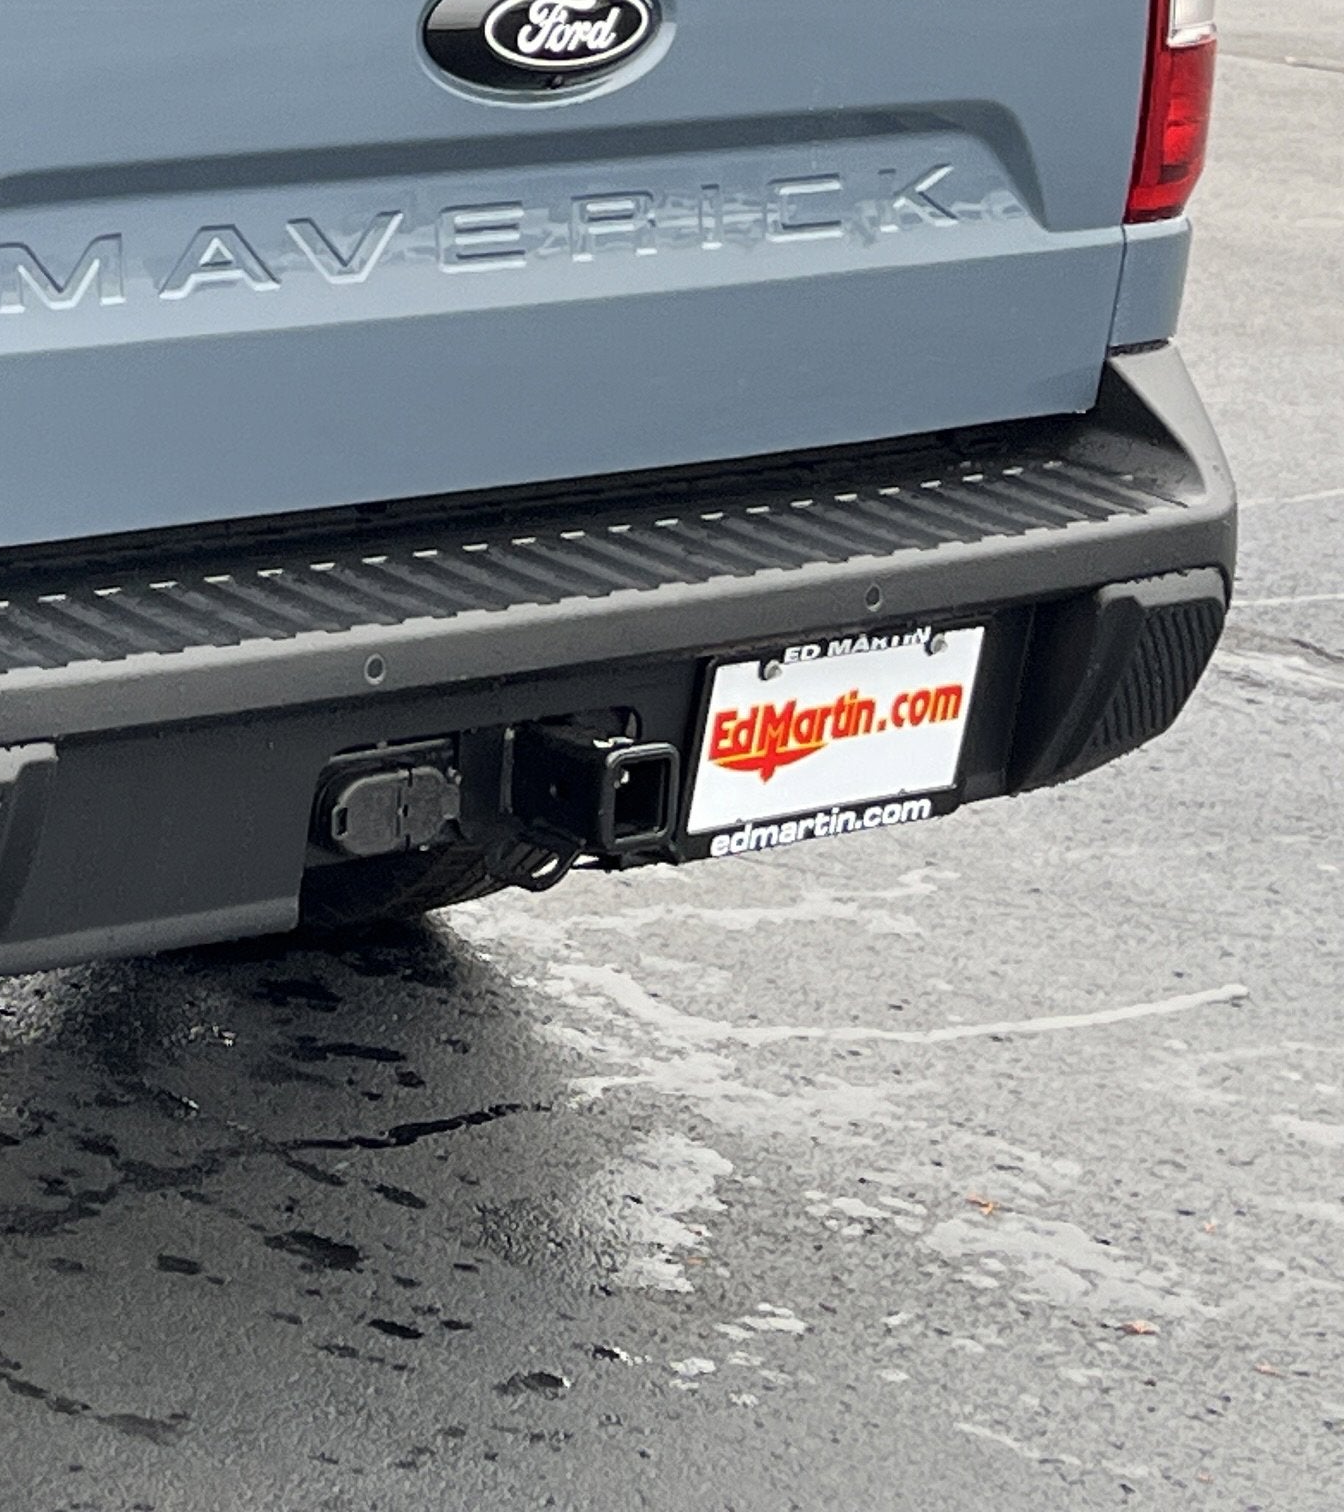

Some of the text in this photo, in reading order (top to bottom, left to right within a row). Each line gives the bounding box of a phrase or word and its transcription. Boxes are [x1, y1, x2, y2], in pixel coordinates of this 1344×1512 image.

[784, 644, 821, 664] ED
[708, 684, 963, 762] EdMartin.com
[710, 798, 932, 857] edmartin.com
